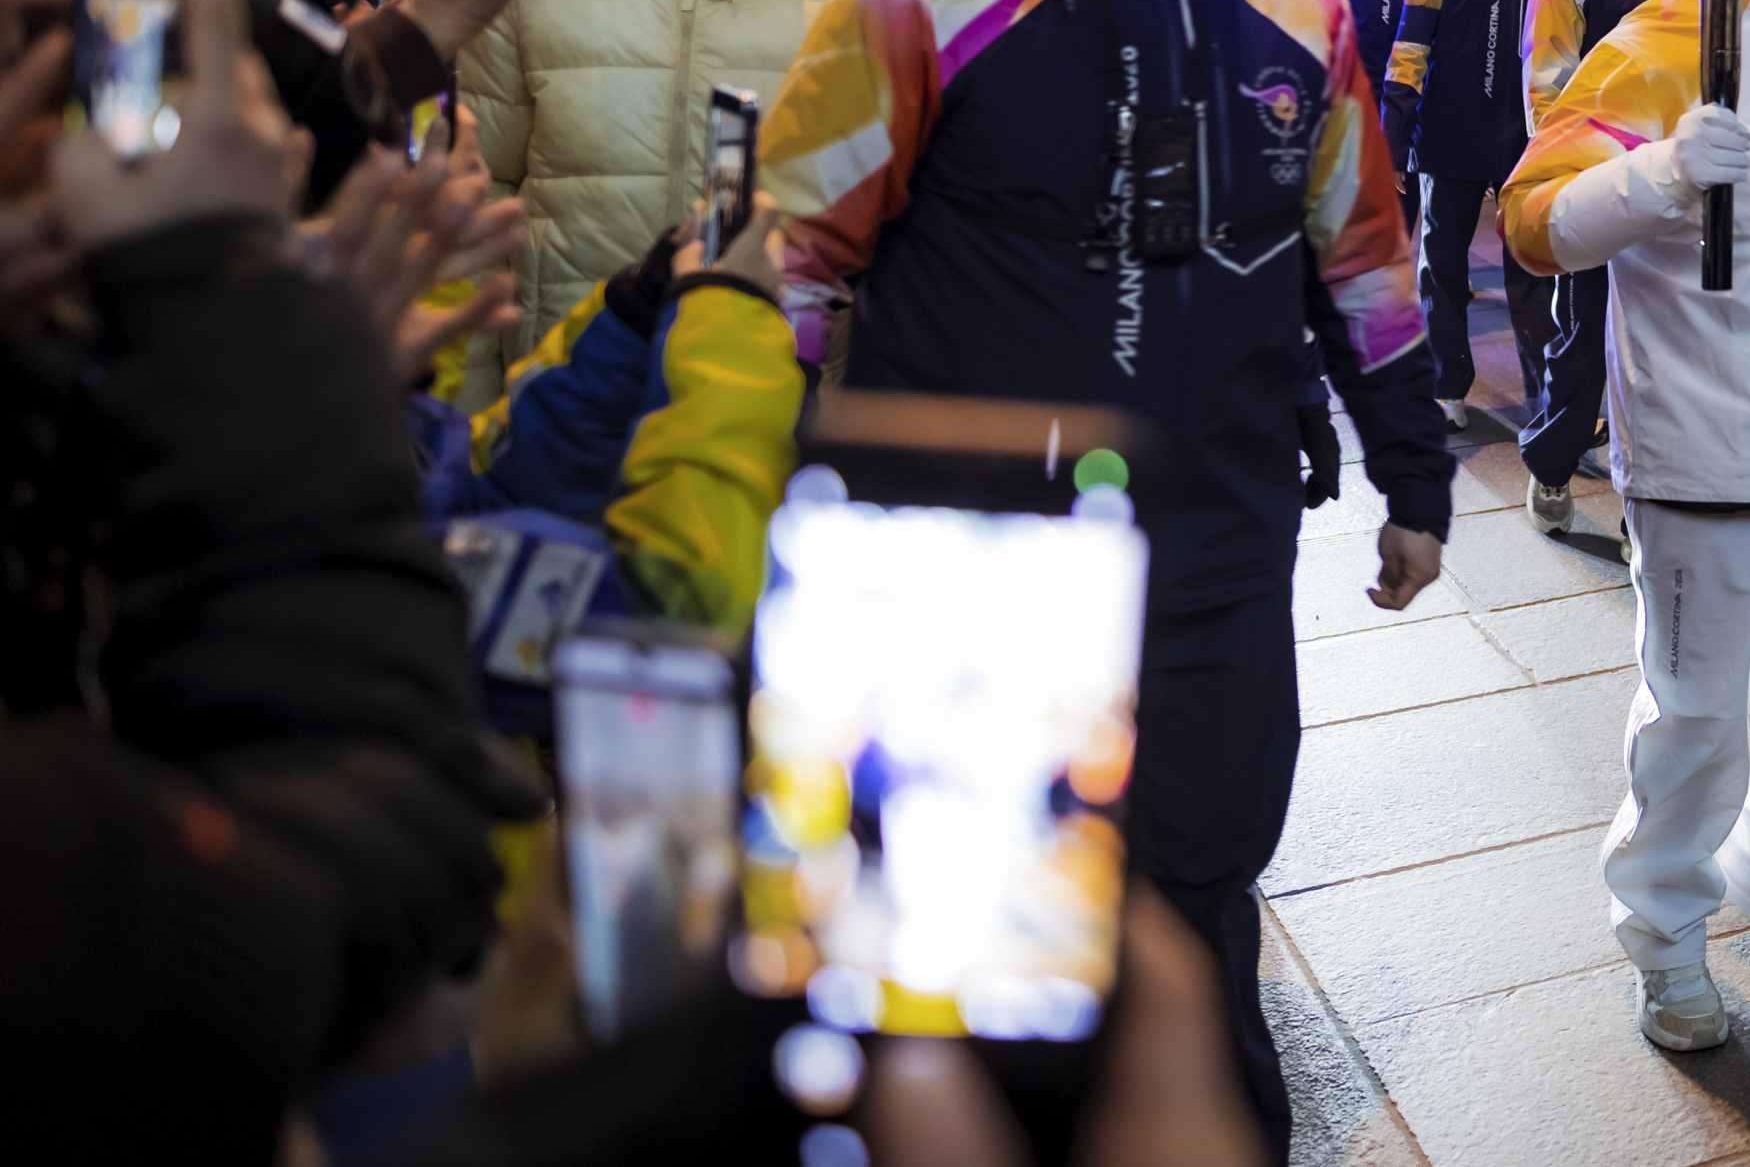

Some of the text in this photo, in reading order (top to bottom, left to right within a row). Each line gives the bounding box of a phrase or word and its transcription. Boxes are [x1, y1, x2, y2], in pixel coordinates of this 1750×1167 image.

[1487, 0, 1500, 50] CORTINA
[1483, 49, 1495, 99] MILANO
[1670, 568, 1683, 679] MILANO CORTINA 2026
